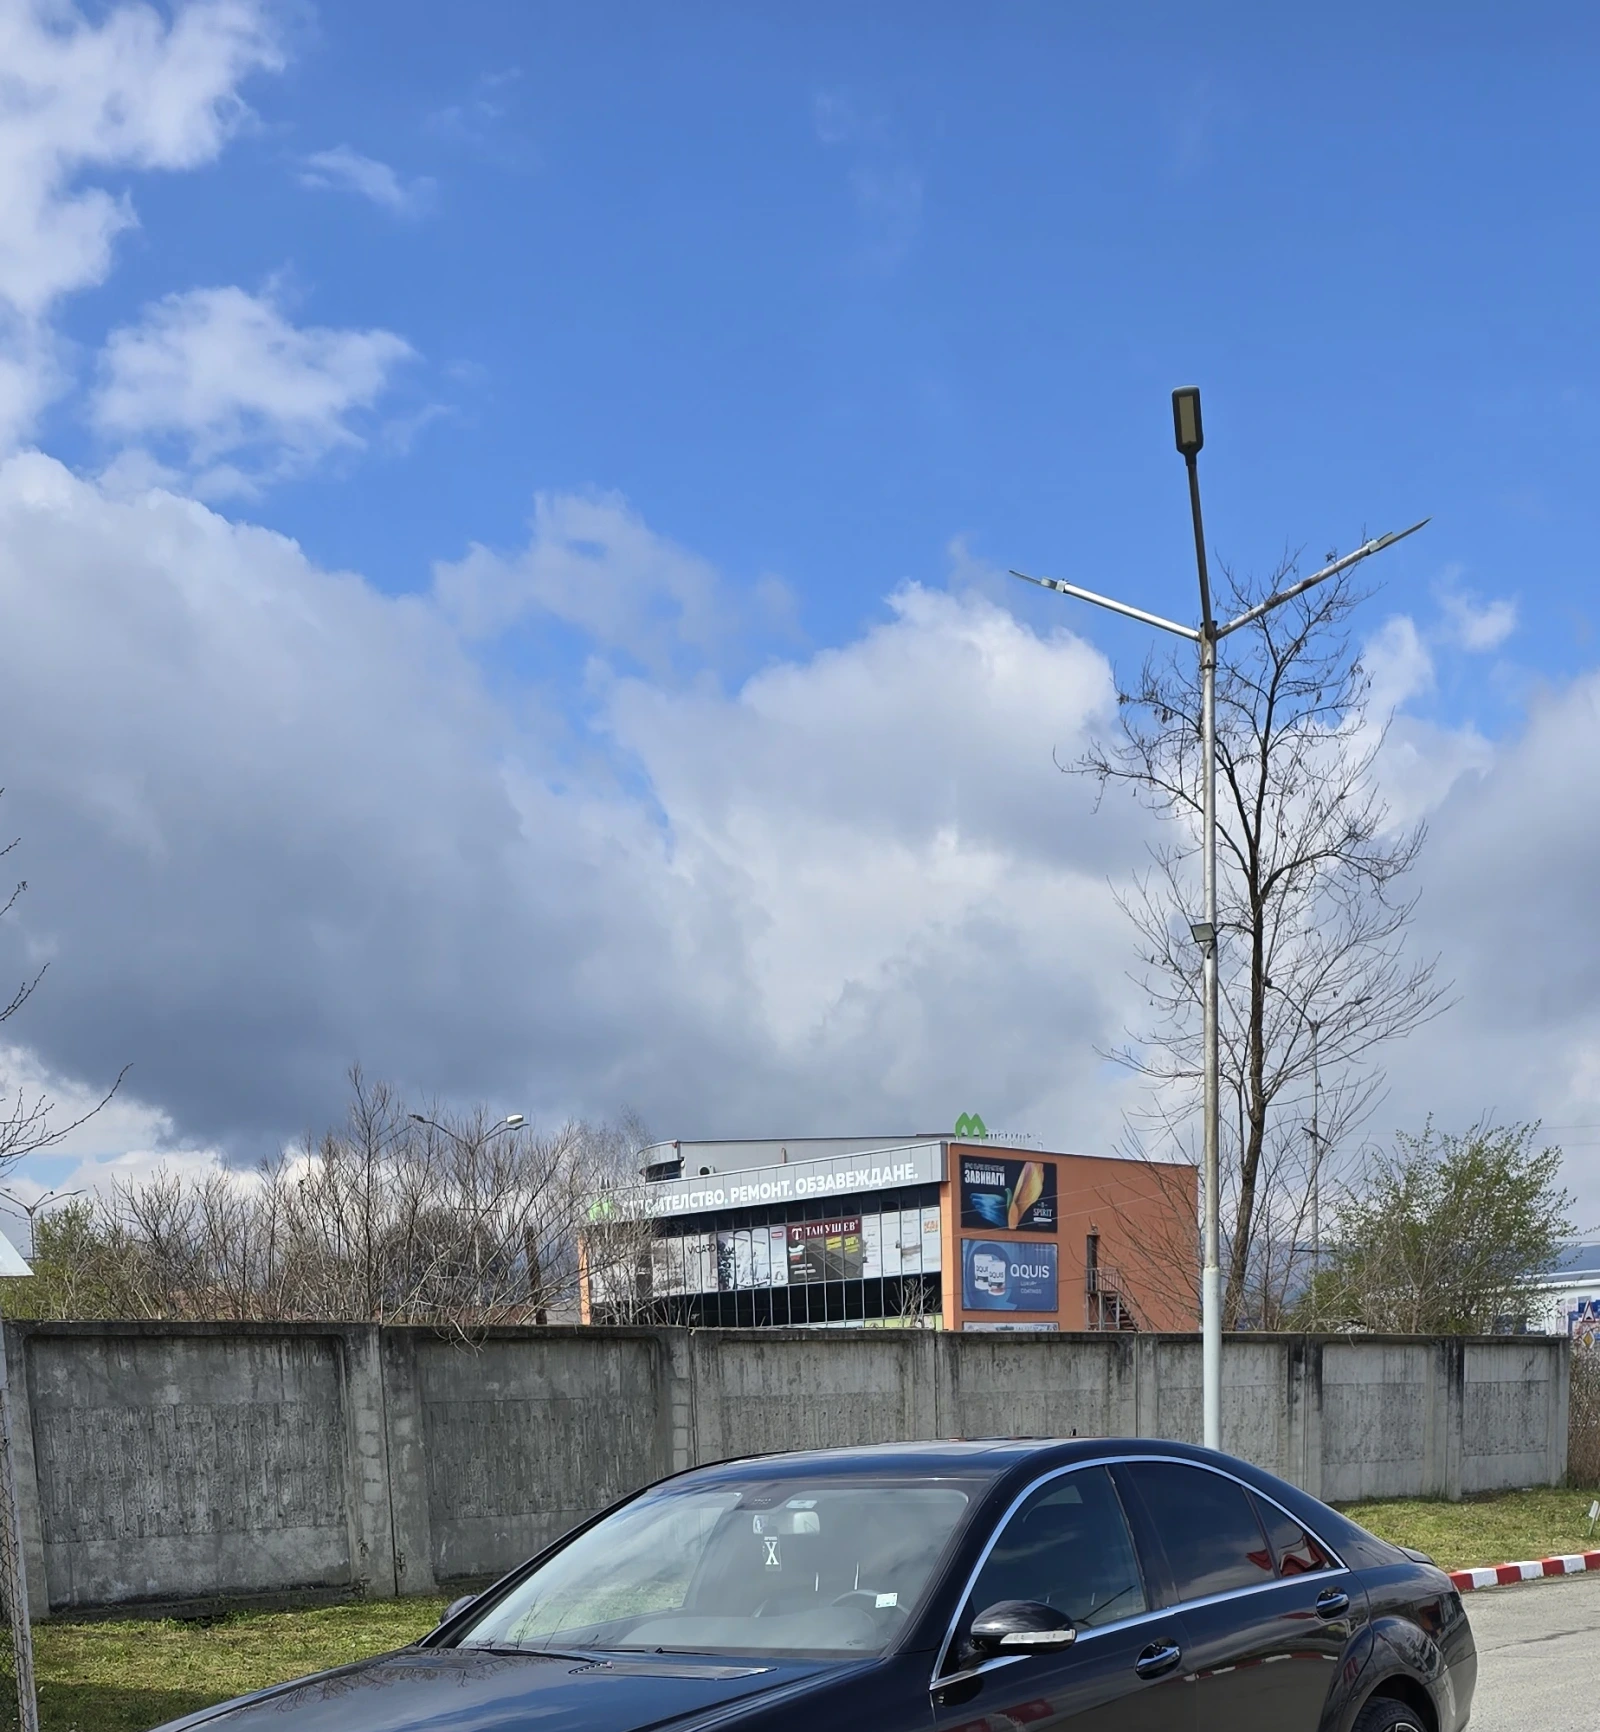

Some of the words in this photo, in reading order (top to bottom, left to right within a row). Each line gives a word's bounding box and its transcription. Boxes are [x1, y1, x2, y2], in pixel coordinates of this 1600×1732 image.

[731, 1180, 792, 1203] РЕМОНТ.
[795, 1163, 918, 1195] ОБЗАВЕЖДАНЕ.
[964, 1169, 1005, 1186] ЗАВИНАГИ
